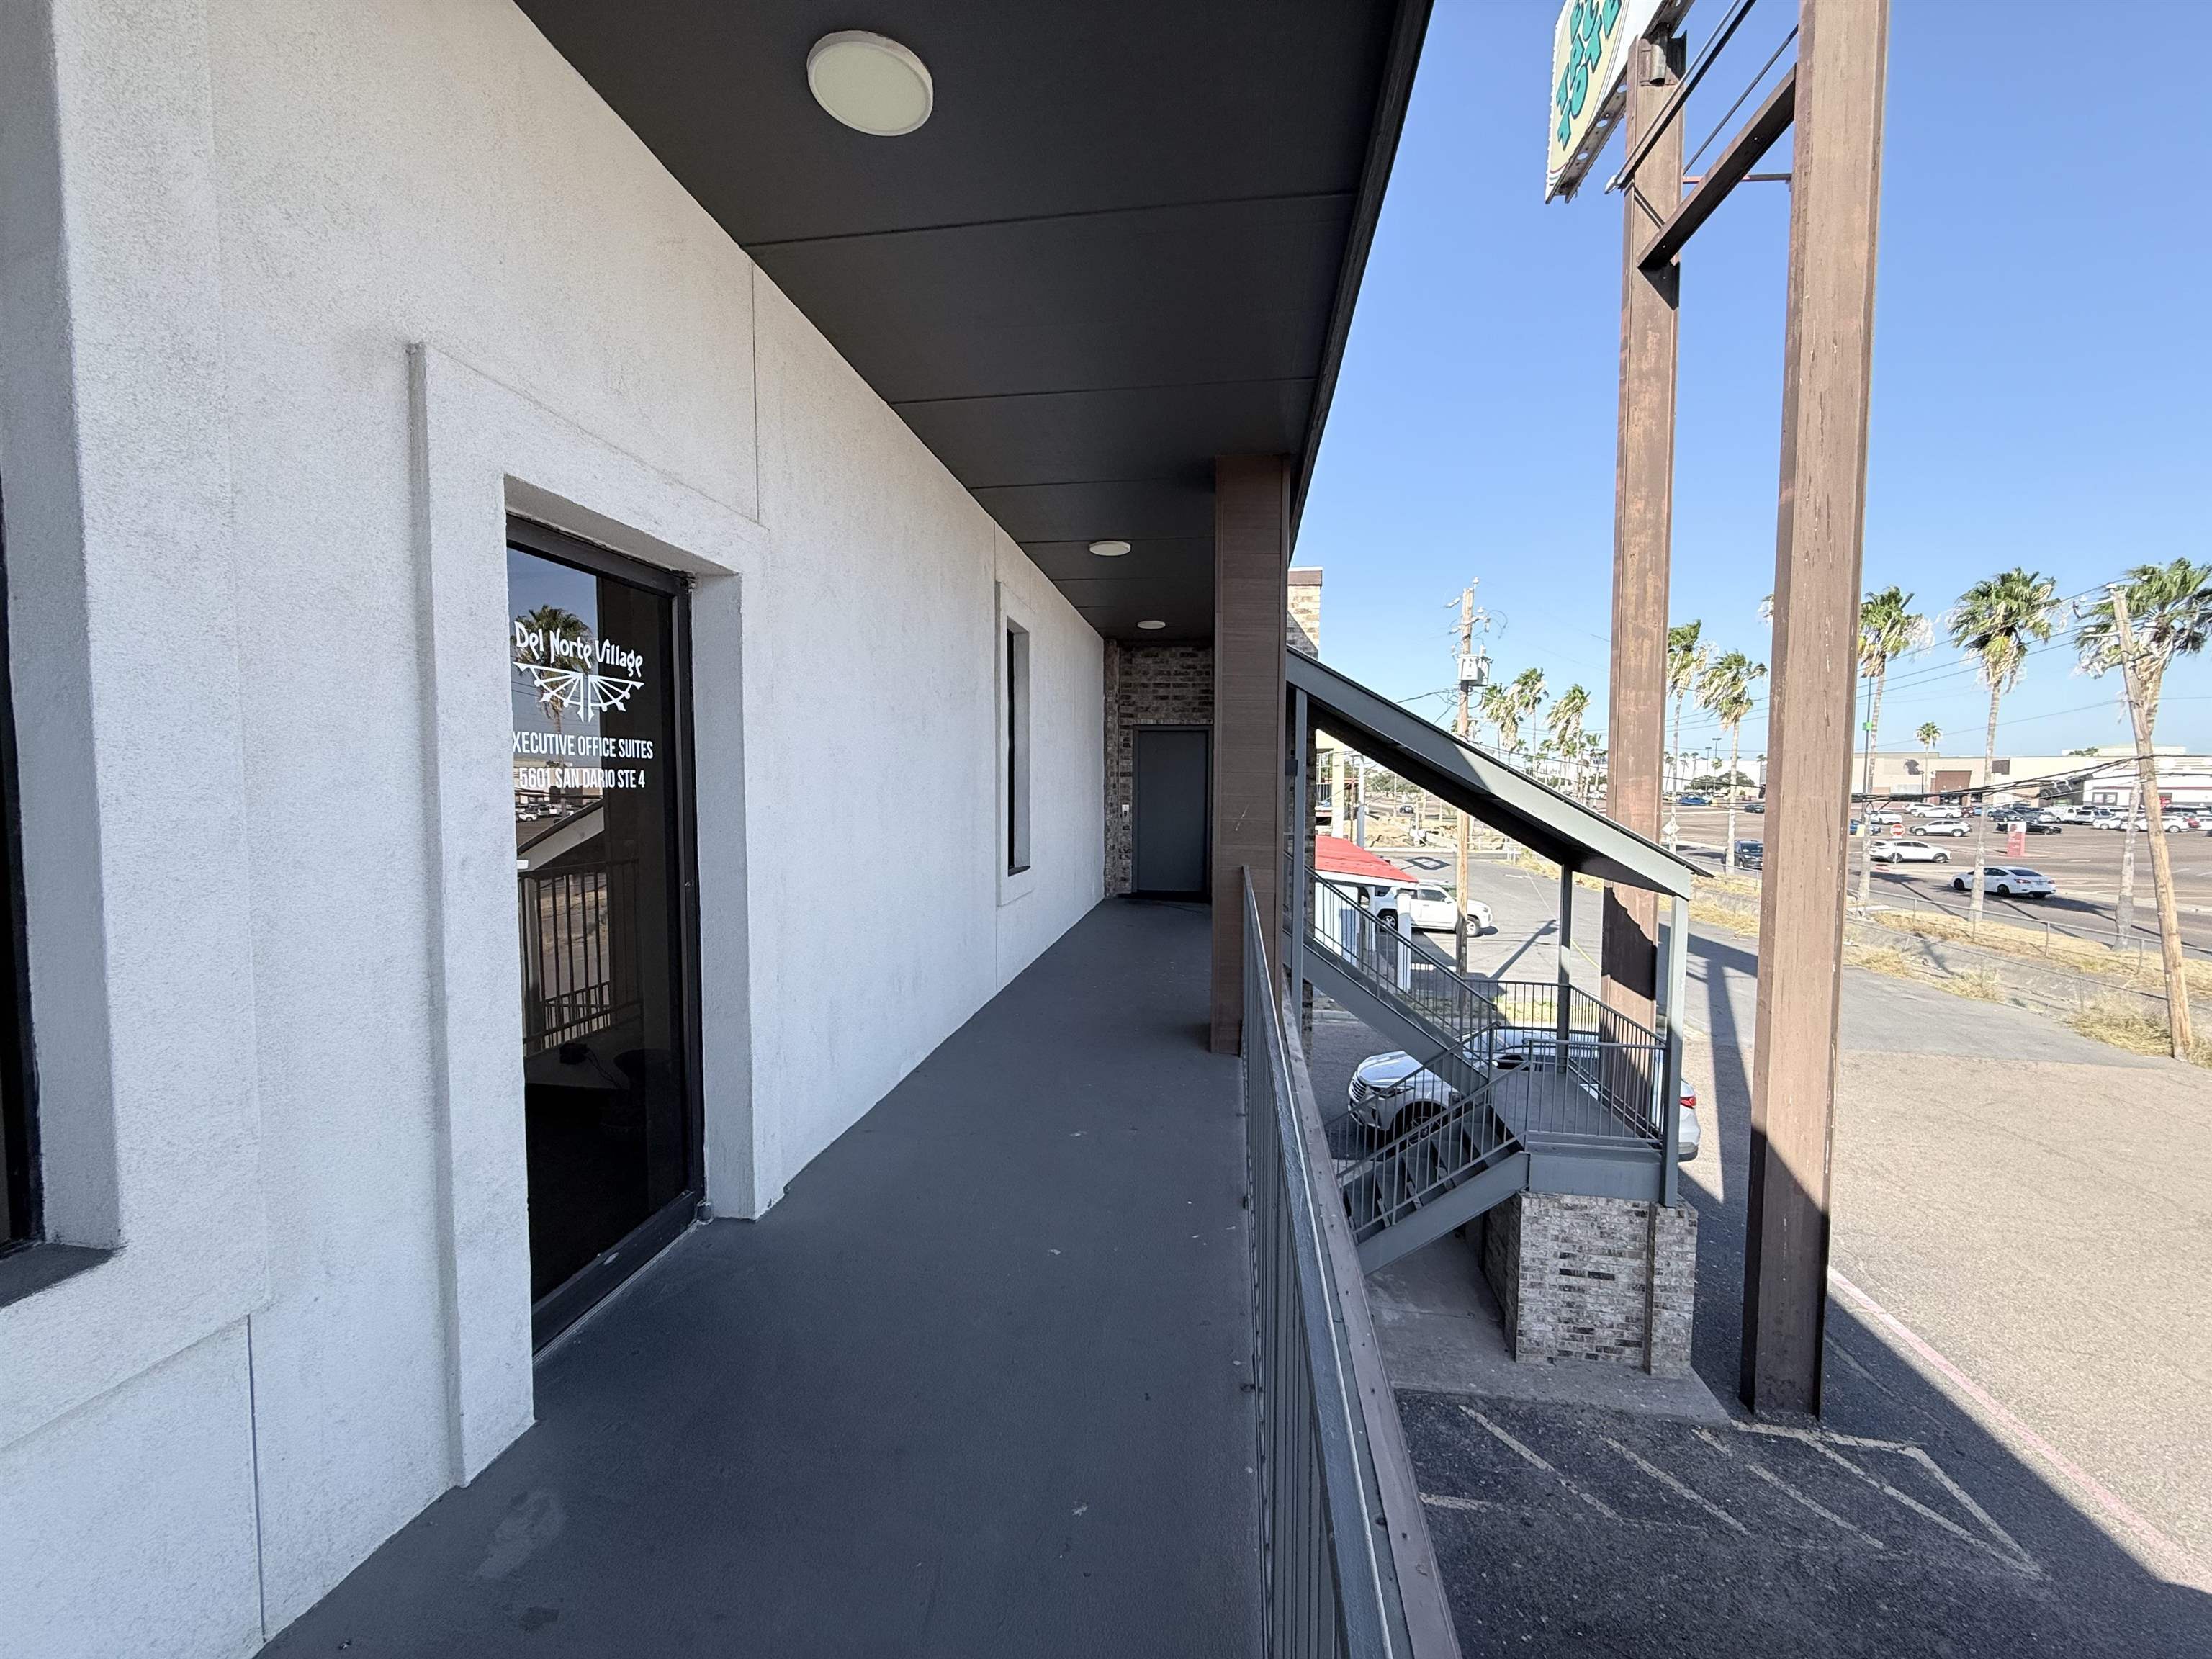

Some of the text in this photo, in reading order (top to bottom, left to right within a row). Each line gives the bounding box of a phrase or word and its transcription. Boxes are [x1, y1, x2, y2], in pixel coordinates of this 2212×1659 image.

[514, 621, 643, 678] Del Norte Village
[513, 731, 654, 760] XECUTIVE OFFICE SUITES
[519, 767, 646, 788] 5601 SAN DARIO STE 4
